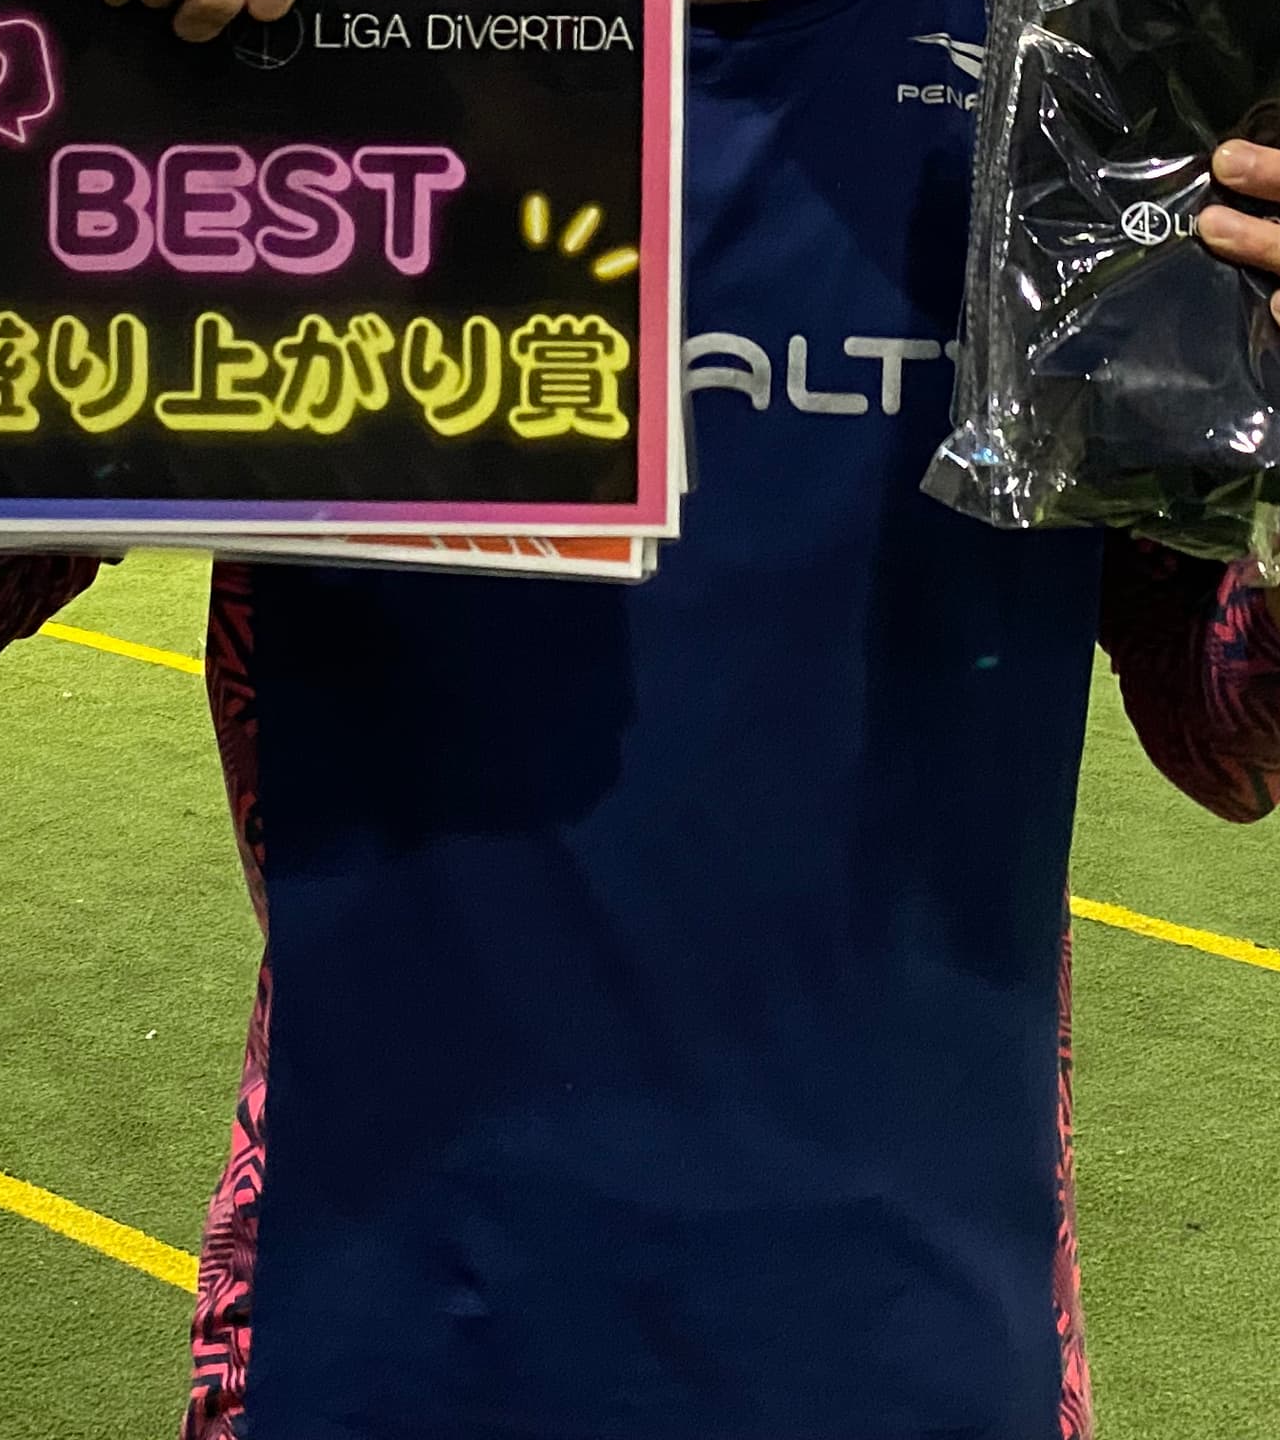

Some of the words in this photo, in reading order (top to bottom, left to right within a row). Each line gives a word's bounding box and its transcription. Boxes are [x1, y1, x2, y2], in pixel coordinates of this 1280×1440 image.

[897, 83, 980, 111] PENA
[48, 144, 465, 275] BEST
[683, 332, 960, 415] ALT
